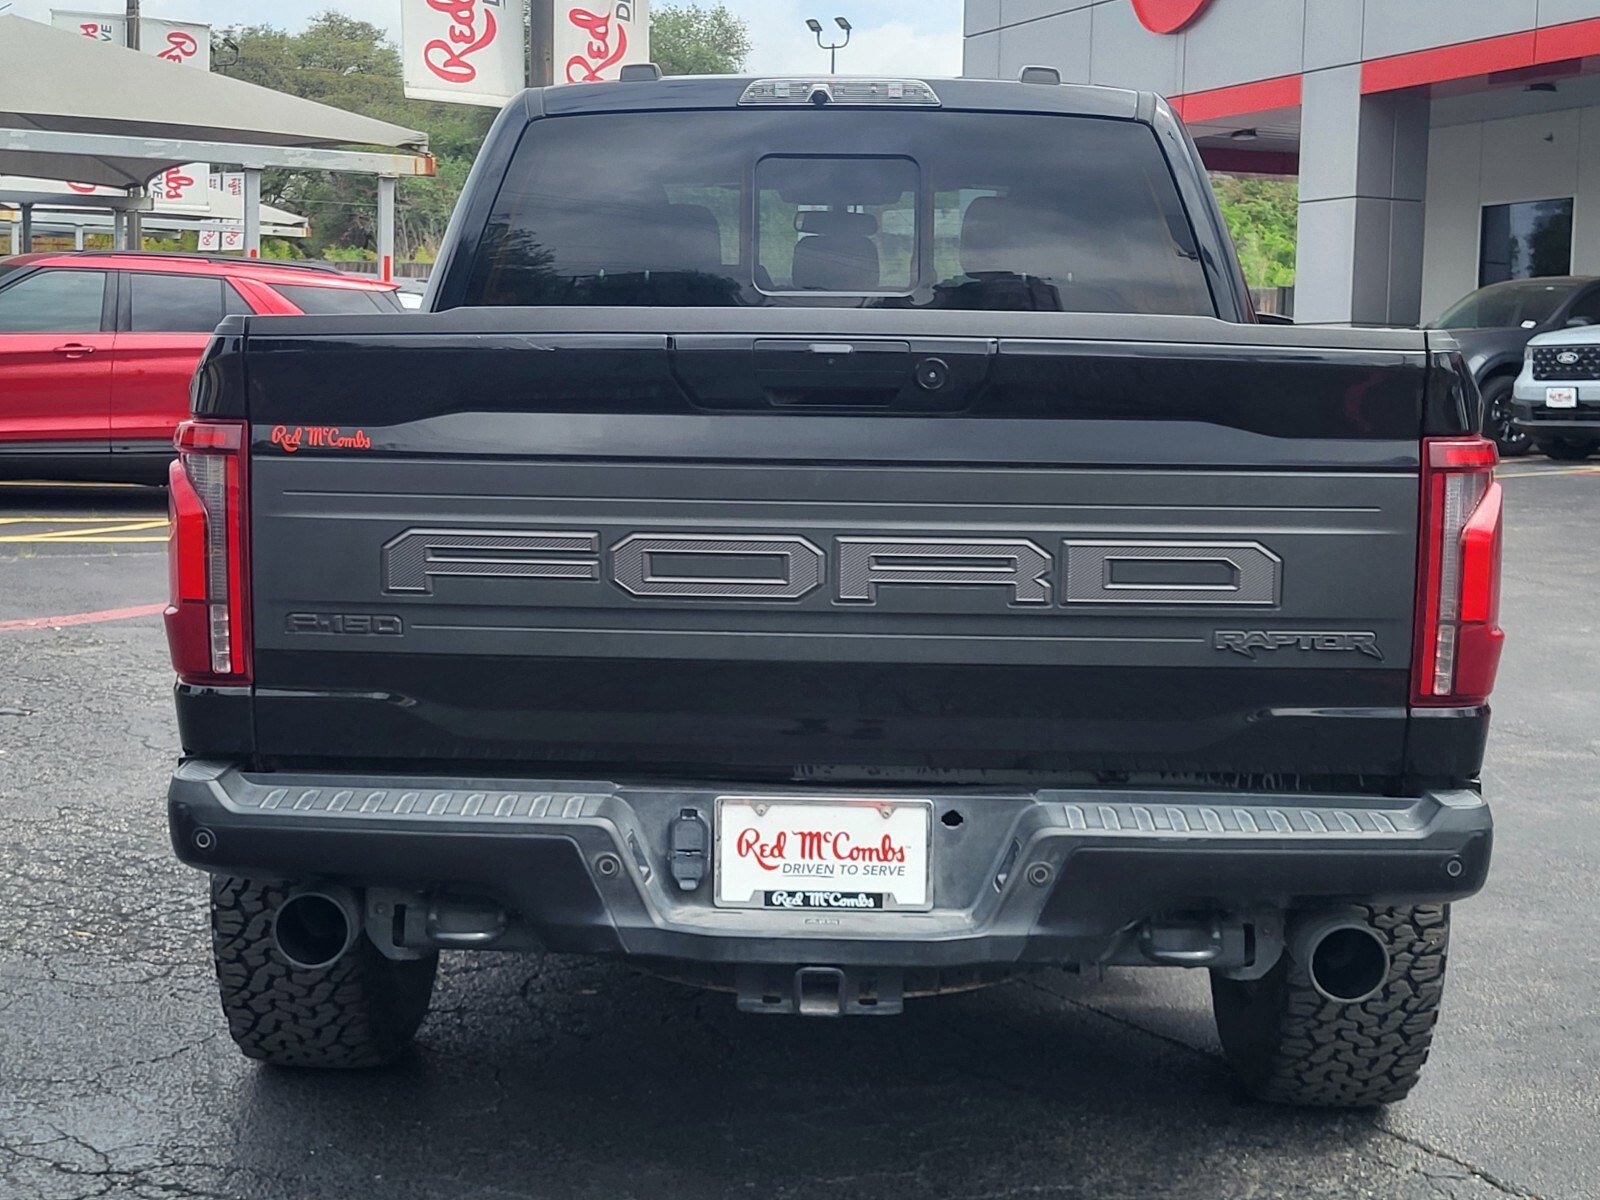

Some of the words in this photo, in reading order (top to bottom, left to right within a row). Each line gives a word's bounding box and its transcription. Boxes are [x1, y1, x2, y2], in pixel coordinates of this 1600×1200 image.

[566, 8, 627, 83] Red
[271, 425, 303, 452] Red
[304, 426, 371, 449] McCombs
[381, 526, 1283, 608] FORD
[285, 612, 404, 637] F-150
[1214, 630, 1386, 662] RAPTOR
[736, 827, 787, 871] Red
[791, 830, 906, 863] McCombs
[781, 863, 835, 875] DRIVEN
[839, 864, 859, 876] TO
[862, 864, 906, 877] SERVE
[771, 891, 804, 908] Red
[806, 891, 875, 909] McCombs
